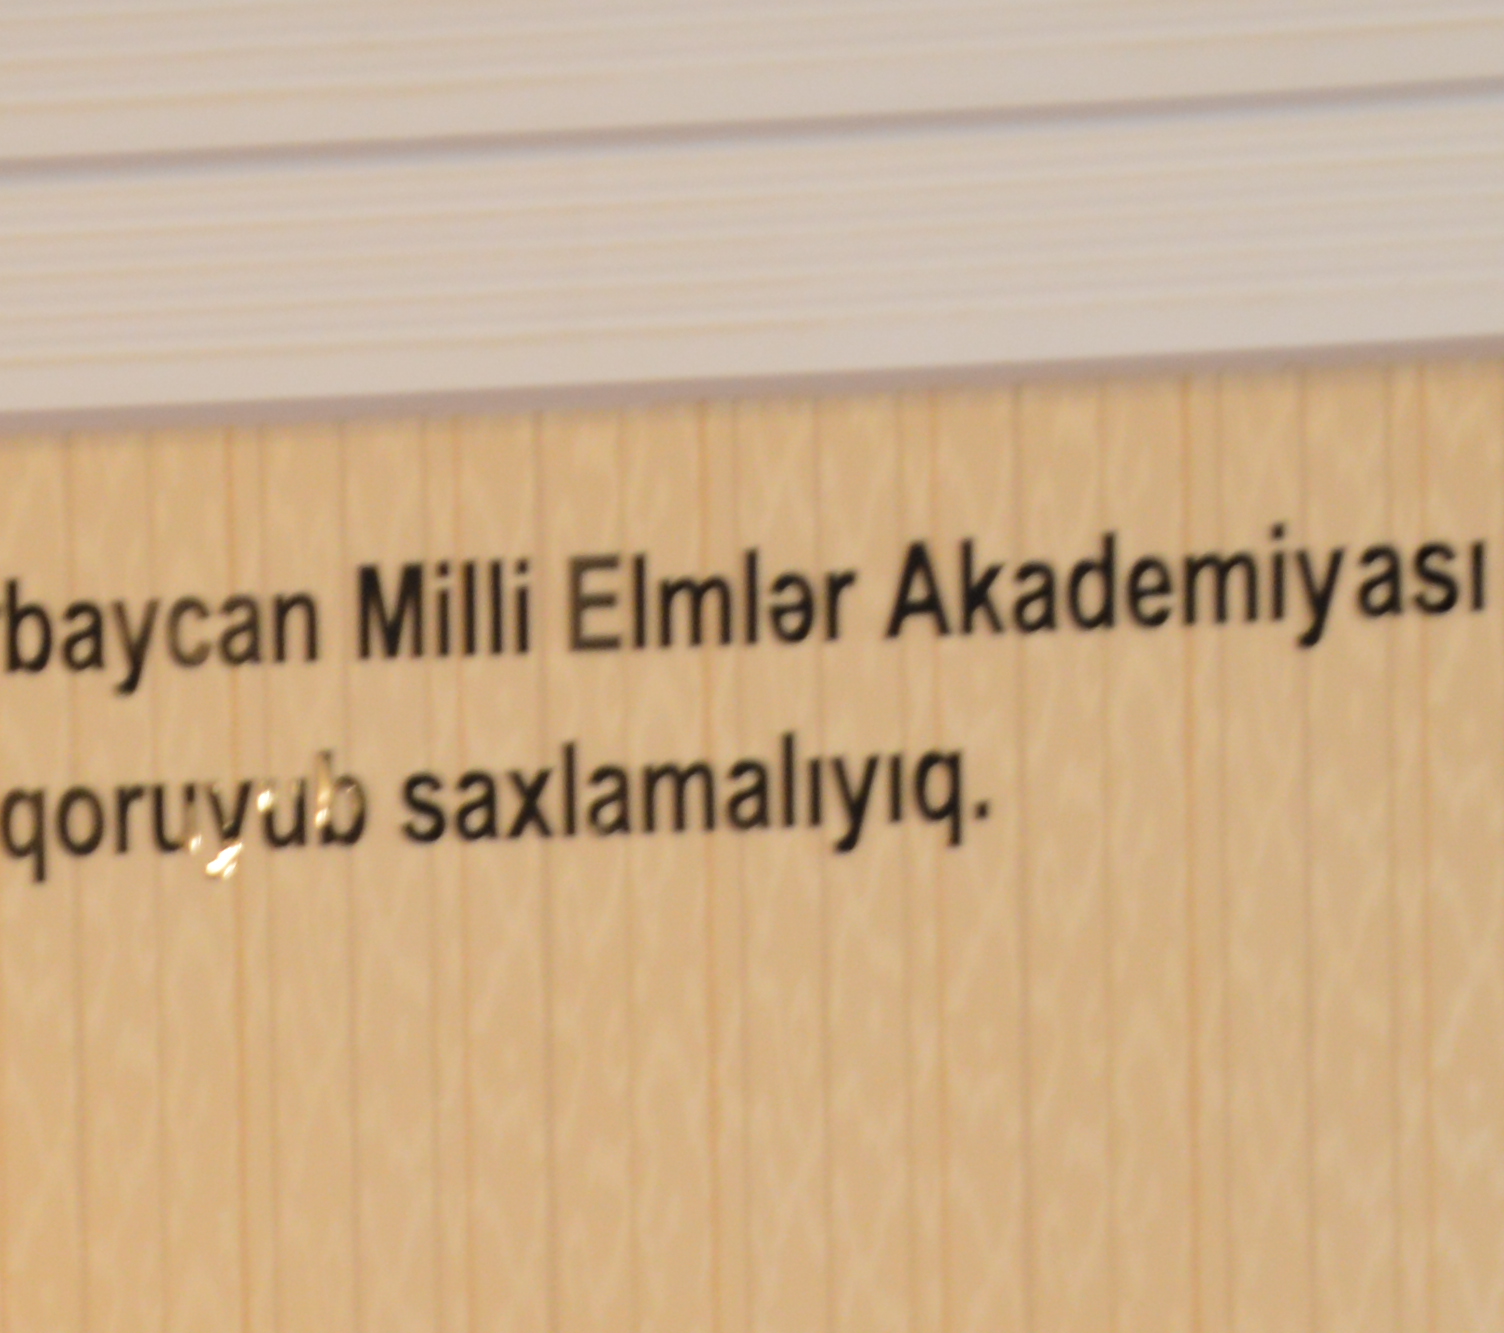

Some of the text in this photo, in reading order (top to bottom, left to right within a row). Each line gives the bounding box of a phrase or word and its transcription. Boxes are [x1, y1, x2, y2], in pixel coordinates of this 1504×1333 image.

[355, 558, 532, 662] Milli
[567, 547, 858, 653] Elmlər
[882, 521, 1487, 651] Akademiyası
[401, 730, 991, 856] saxlamalıyıq.
